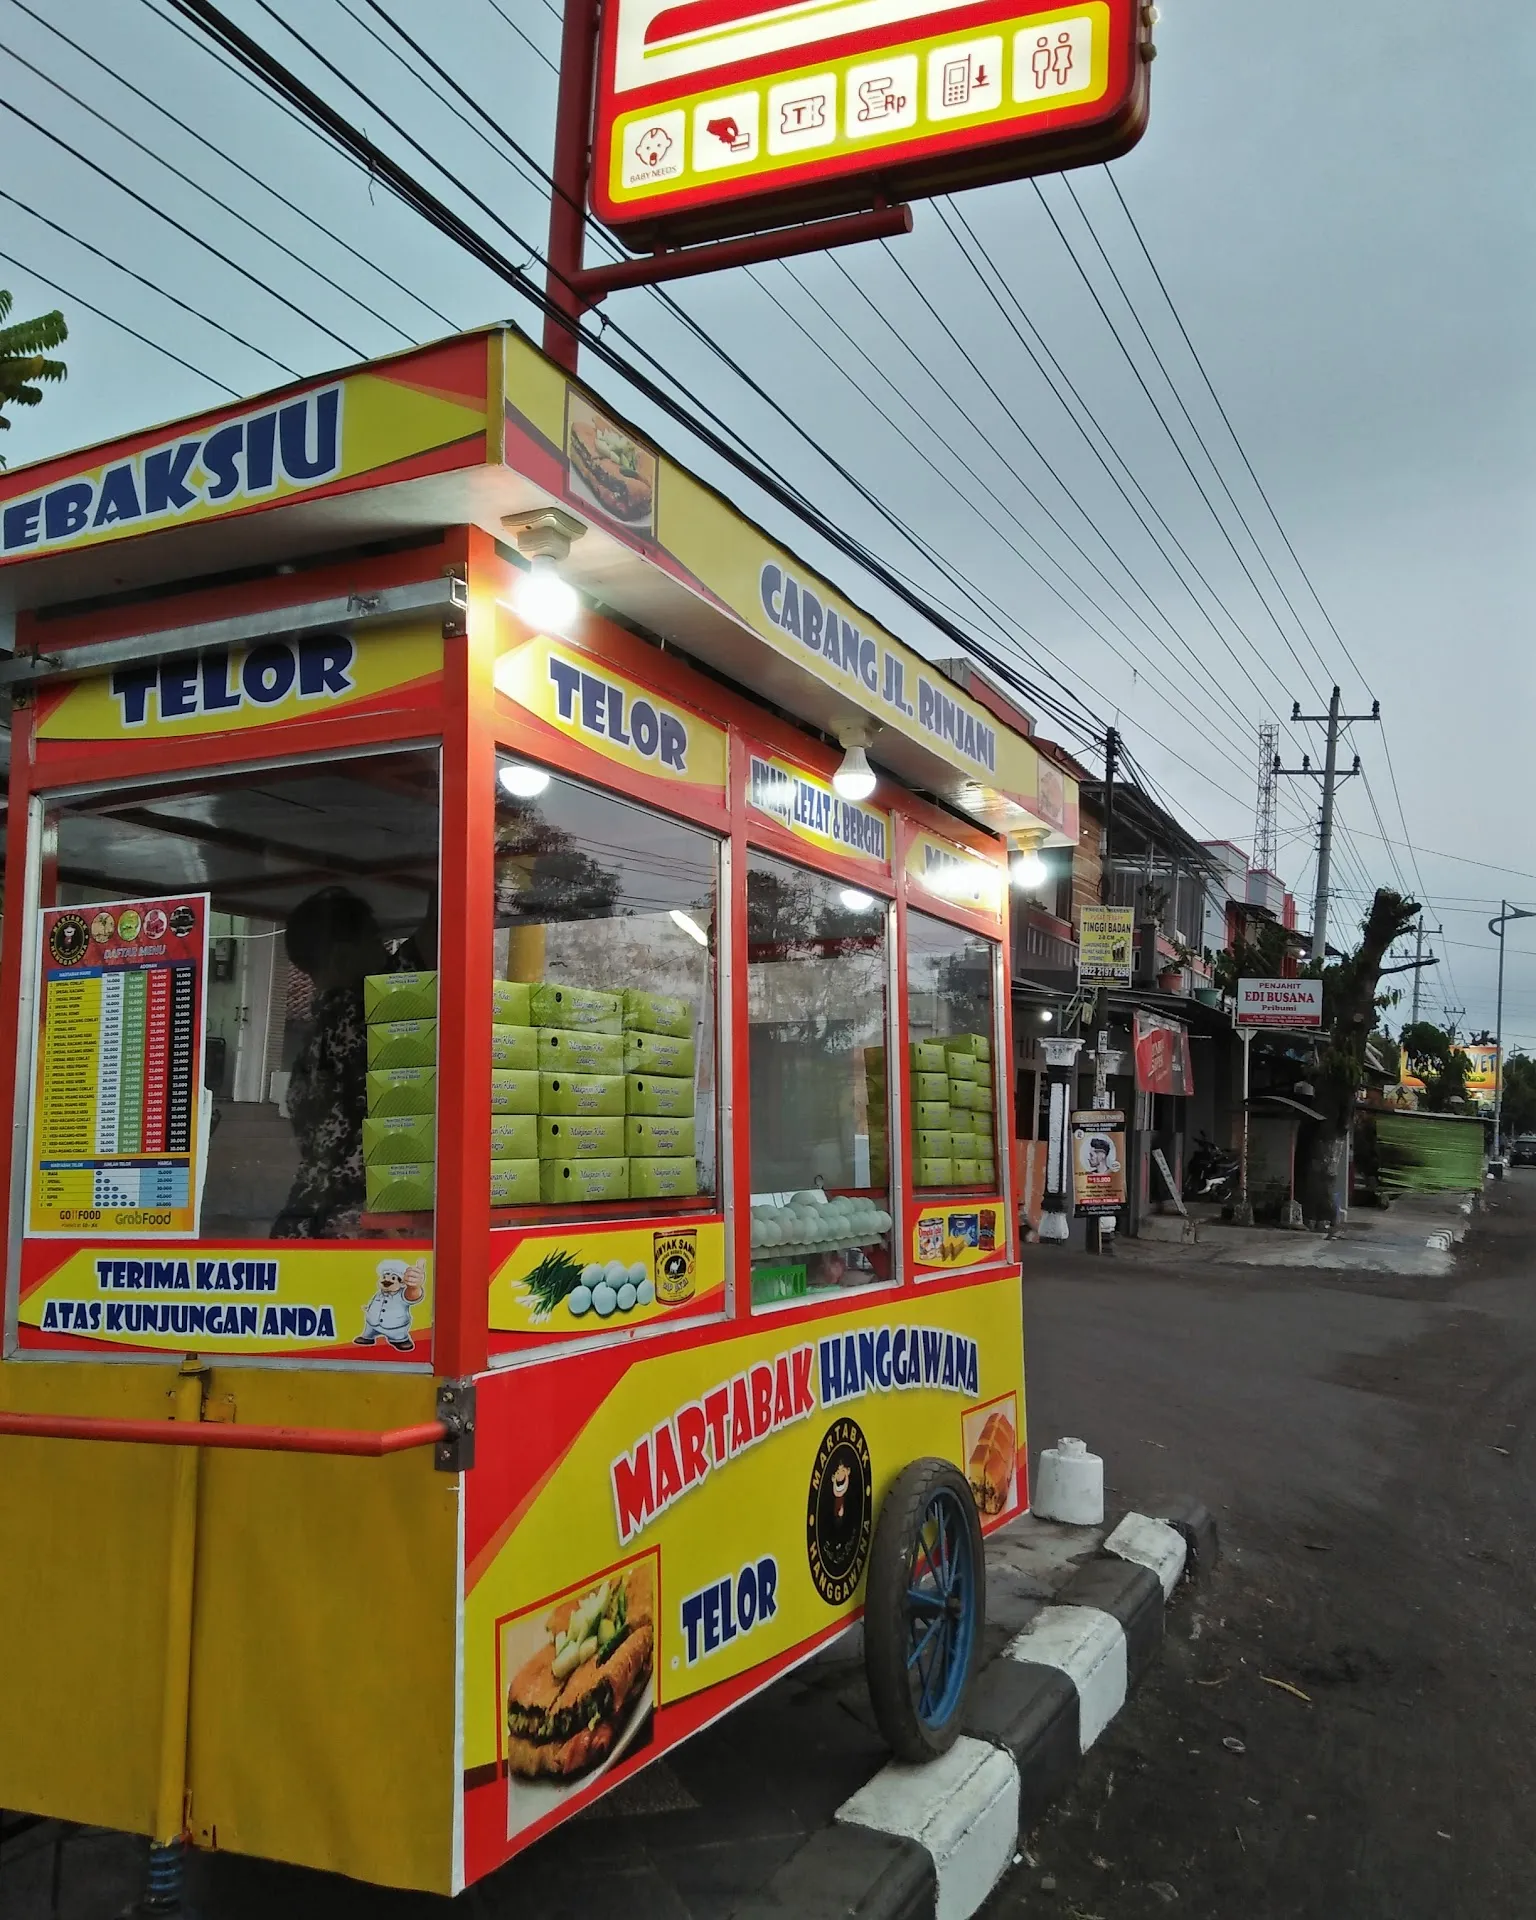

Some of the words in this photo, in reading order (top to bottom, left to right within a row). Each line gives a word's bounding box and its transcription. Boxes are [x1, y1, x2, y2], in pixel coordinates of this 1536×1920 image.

[884, 94, 907, 113] Rp
[629, 171, 650, 184] BABY
[651, 165, 677, 178] NEEDS
[2, 389, 339, 550] EBAKSIU
[112, 634, 353, 727] TELOR
[760, 564, 878, 694] CABANG
[882, 656, 913, 717] JL.
[918, 677, 996, 773] RINJANI
[549, 656, 688, 773] TELOR
[793, 778, 831, 835] LEZAT
[833, 799, 841, 839] &
[842, 801, 885, 860] BERGIZI
[103, 947, 138, 960] DAFTAR
[138, 945, 166, 957] MENU
[1083, 922, 1107, 932] TINGGI
[1108, 922, 1131, 933] BADAN
[1097, 967, 1113, 977] 2197
[1244, 991, 1265, 1002] EDI
[1266, 992, 1315, 1003] BUSANA
[1262, 1004, 1297, 1012] Pribumi
[97, 1261, 191, 1290] TERIMA
[196, 1262, 278, 1291] KASIH
[42, 1302, 101, 1330] ATAS
[106, 1304, 257, 1335] KUNJUNGAN
[262, 1307, 335, 1337] ANDA
[612, 1348, 815, 1540] MARTABAK
[819, 1328, 979, 1403] HANGGAWANA
[812, 1422, 870, 1491] MARTABAK
[809, 1519, 871, 1601] HANGGAWANA
[682, 1558, 778, 1663] TELOR
